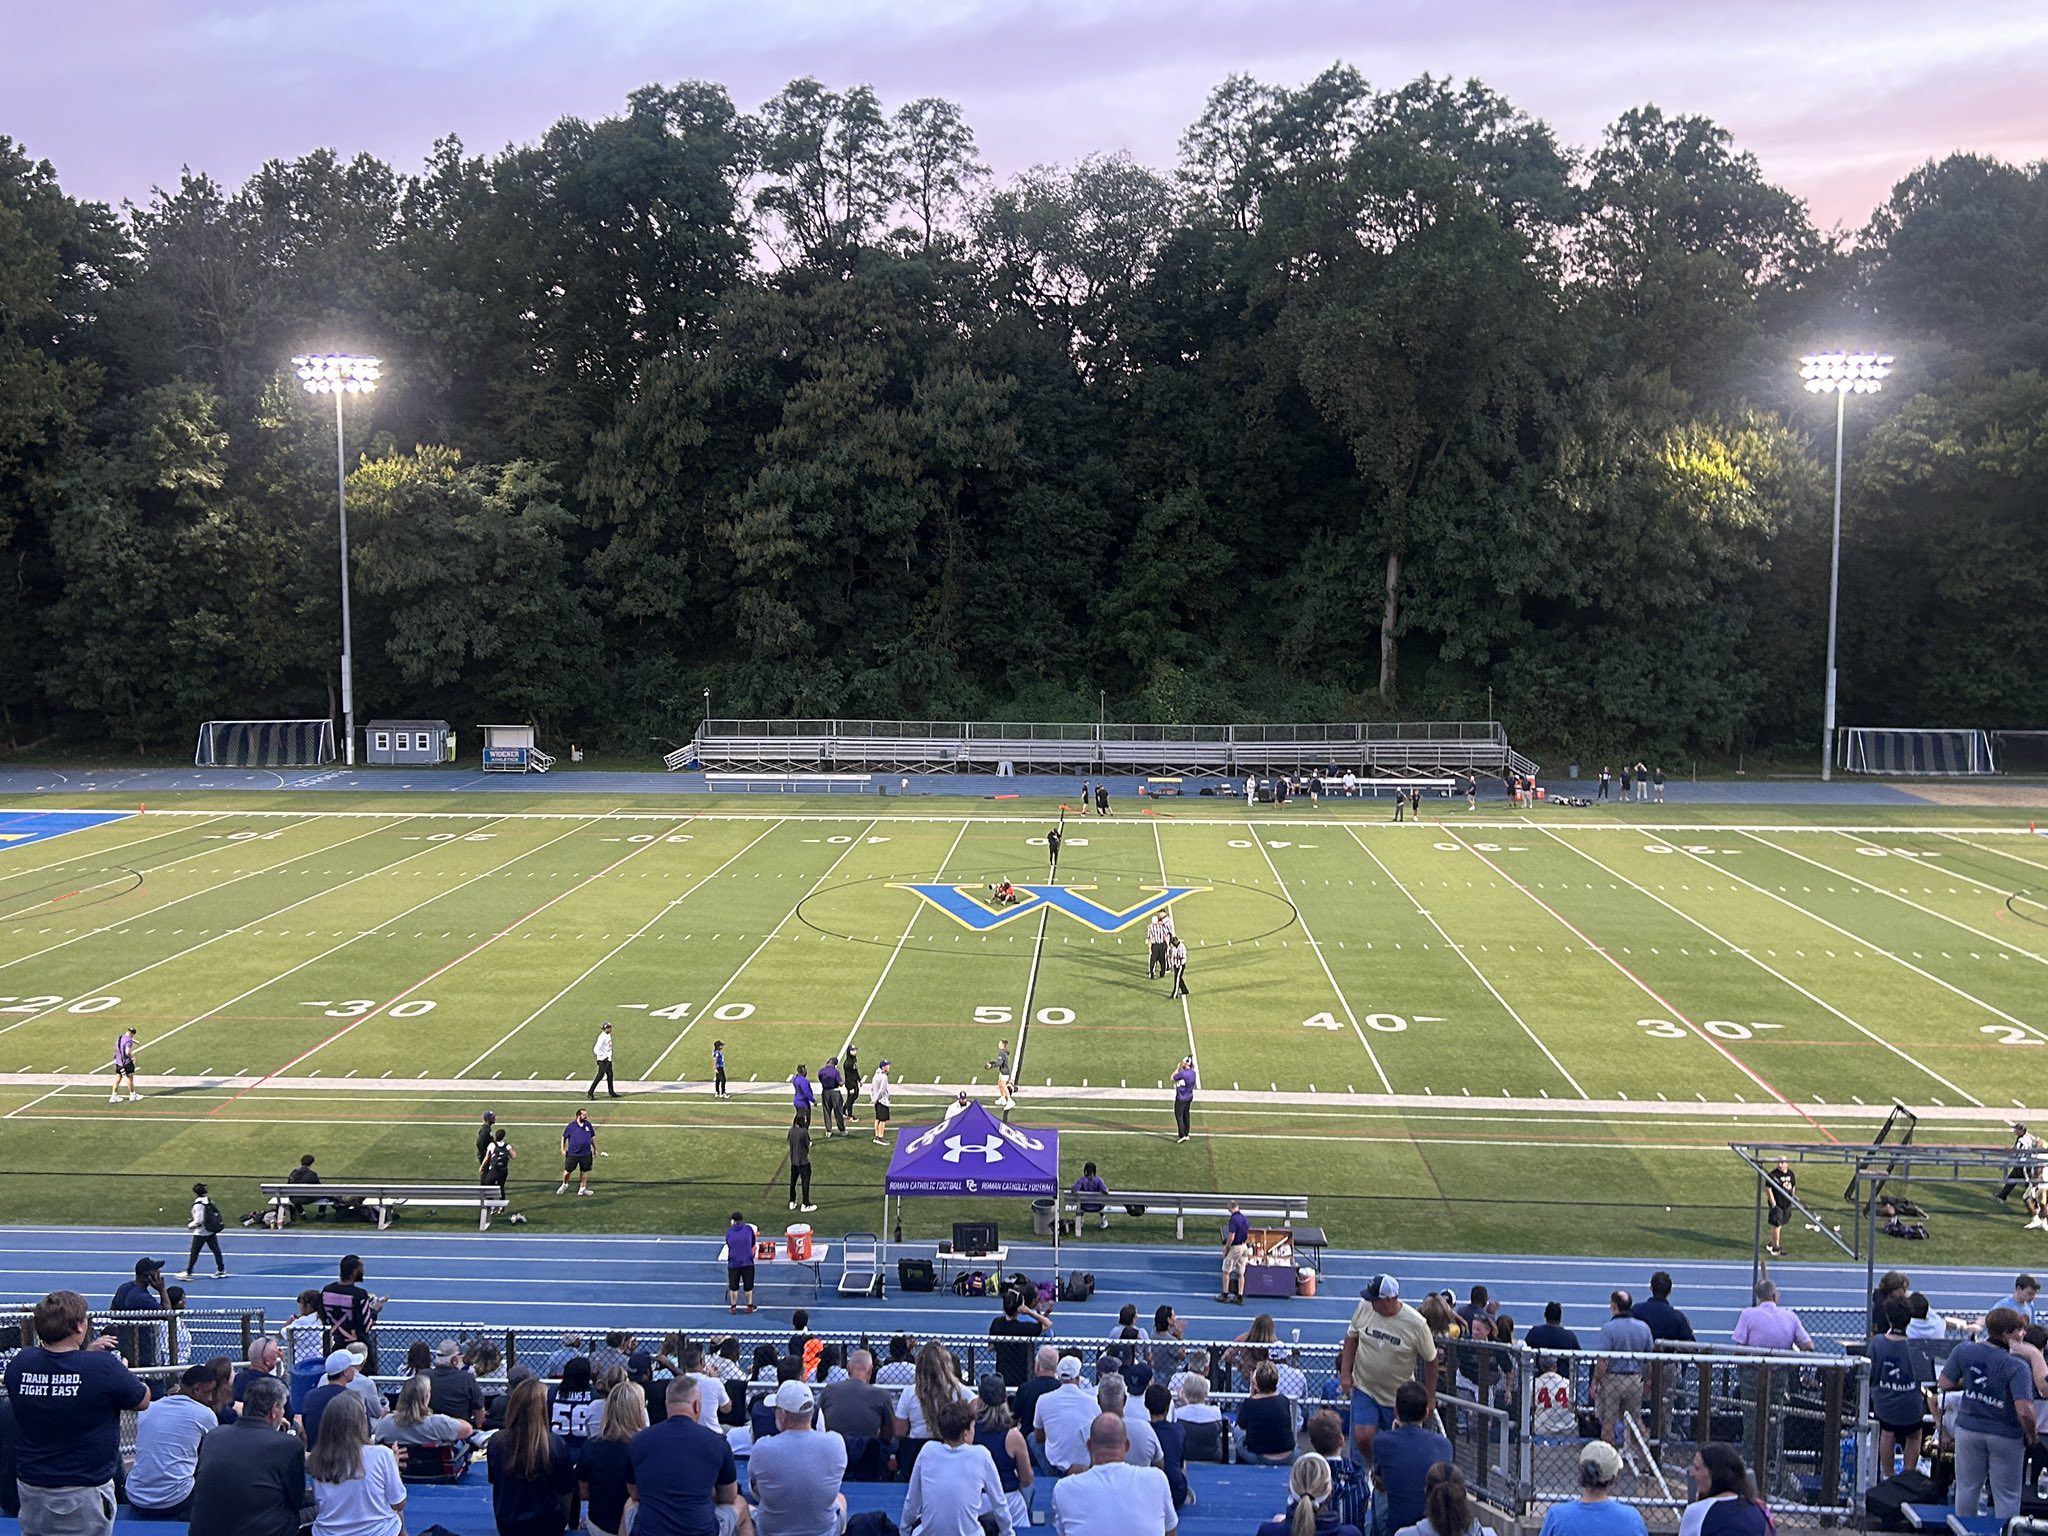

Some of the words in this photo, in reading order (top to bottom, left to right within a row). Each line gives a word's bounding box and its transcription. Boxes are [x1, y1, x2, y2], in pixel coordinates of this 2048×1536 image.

[884, 883, 1214, 932] W
[649, 1002, 757, 1021] 40
[972, 1006, 1077, 1025] 50
[1302, 1012, 1408, 1032] 40
[889, 1181, 909, 1190] ROMAN
[910, 1181, 936, 1190] CATHOLIC
[936, 1181, 962, 1190] FOOTBALL
[981, 1181, 1001, 1190] ROMAN
[1002, 1182, 1027, 1191] CATHOLIC
[1028, 1182, 1054, 1191] FOOTBALL
[21, 1372, 49, 1384] TRAIN
[19, 1384, 49, 1395] FIGHT
[51, 1385, 80, 1396] EASY
[1538, 1387, 1568, 1408] 44
